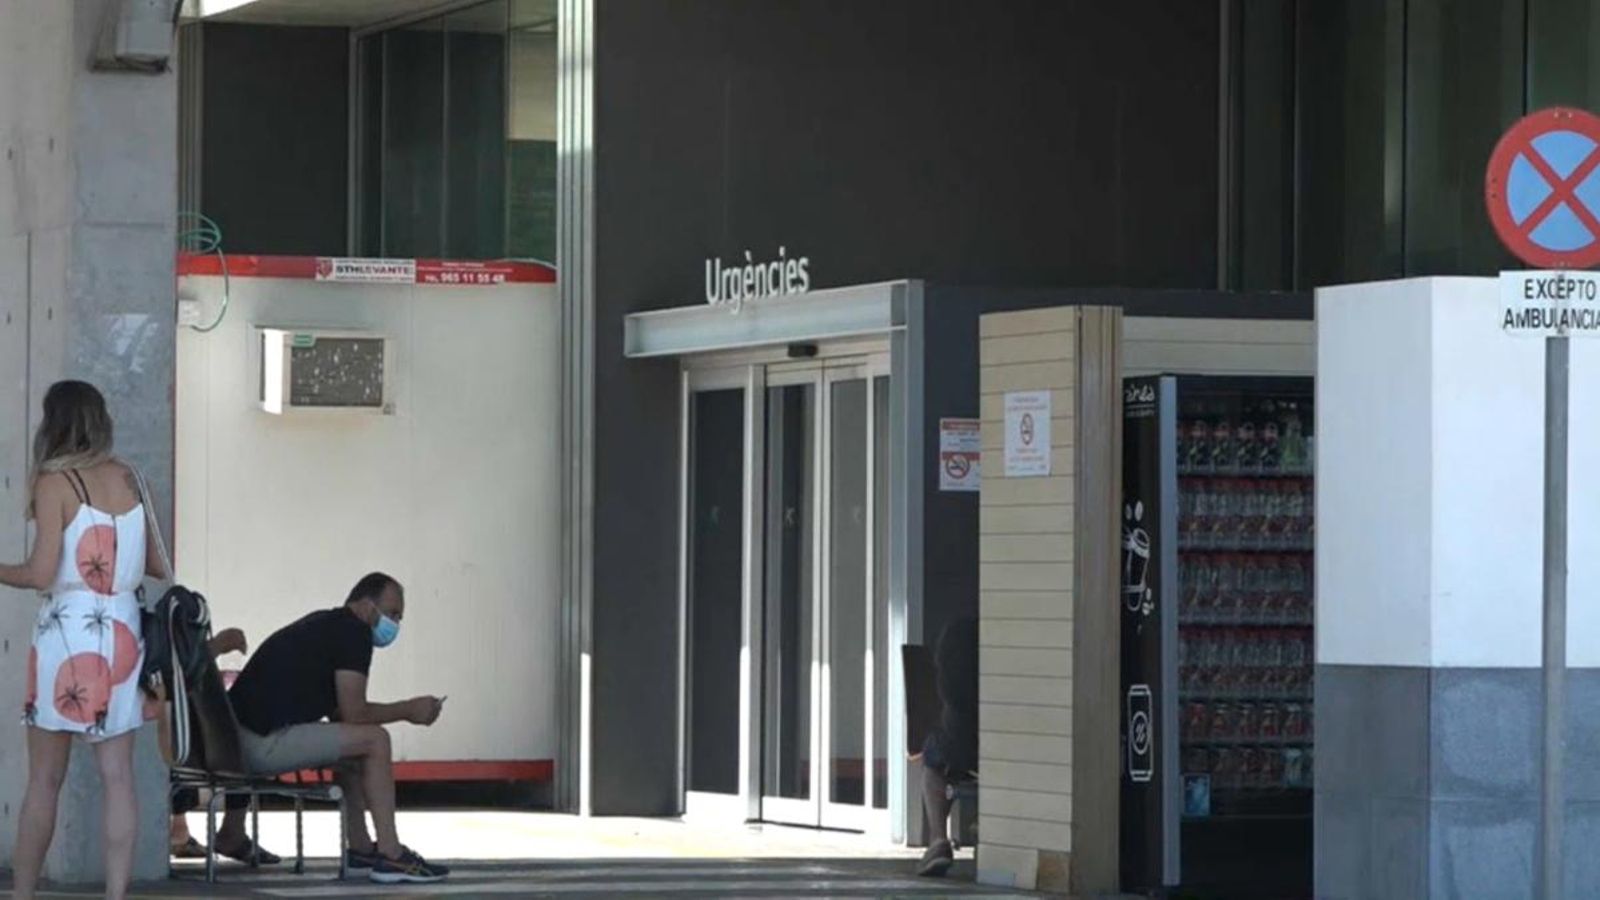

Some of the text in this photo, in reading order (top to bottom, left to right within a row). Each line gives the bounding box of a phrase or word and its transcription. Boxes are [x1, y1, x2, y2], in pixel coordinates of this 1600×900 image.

[463, 273, 474, 282] 11
[705, 246, 810, 314] Urgències
[1524, 278, 1596, 300] EXCEPTO
